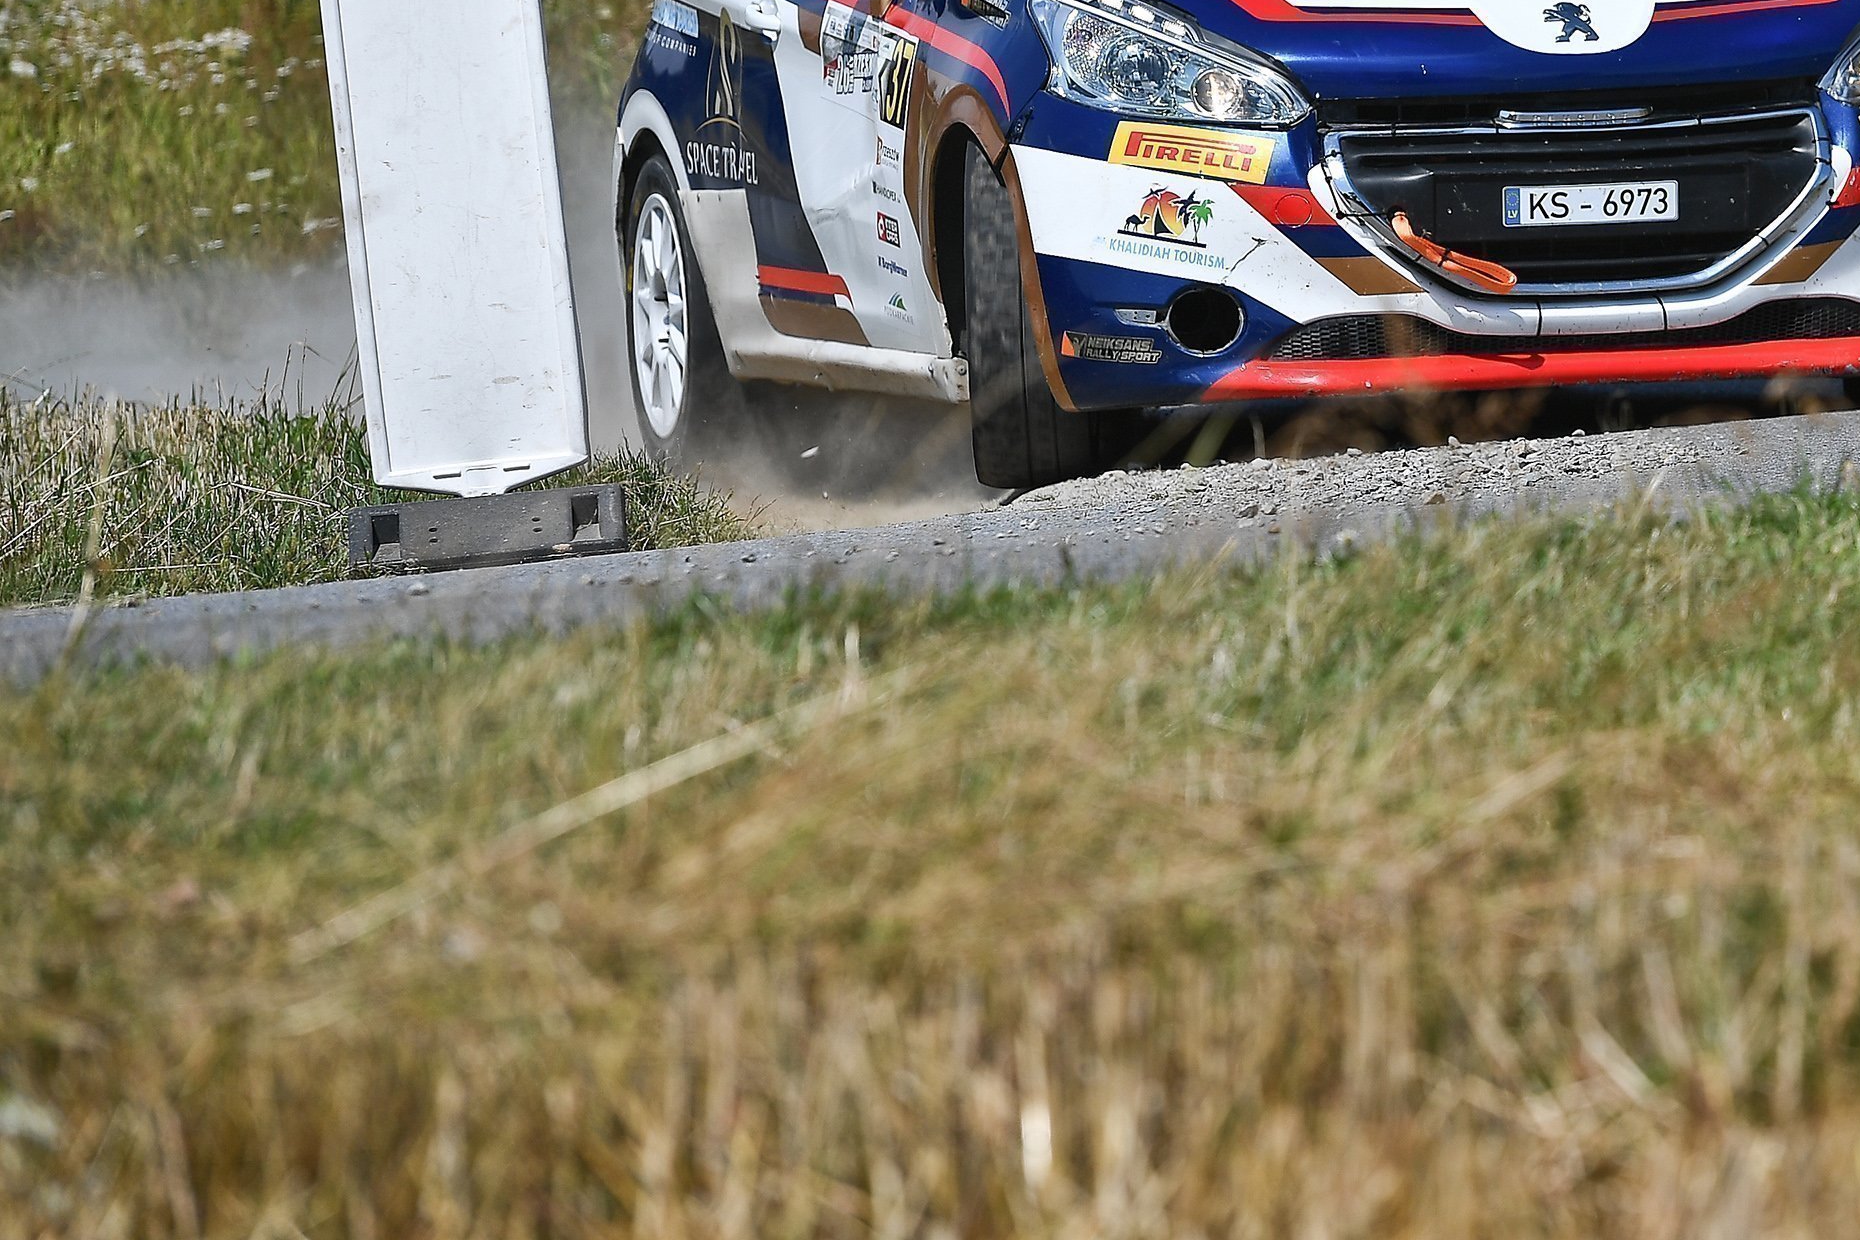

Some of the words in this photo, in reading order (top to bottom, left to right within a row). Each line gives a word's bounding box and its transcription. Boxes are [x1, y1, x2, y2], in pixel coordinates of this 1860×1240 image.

[886, 38, 915, 124] 37
[687, 141, 720, 178] SPACE
[1124, 131, 1257, 173] PIRELLI
[1507, 209, 1519, 219] LV
[1109, 238, 1171, 260] KHALIDIAH
[1174, 248, 1226, 270] TOURISM
[1086, 348, 1119, 359] RALLY
[1120, 351, 1161, 362] SPORT
[1087, 336, 1150, 352] NEIKSANS
